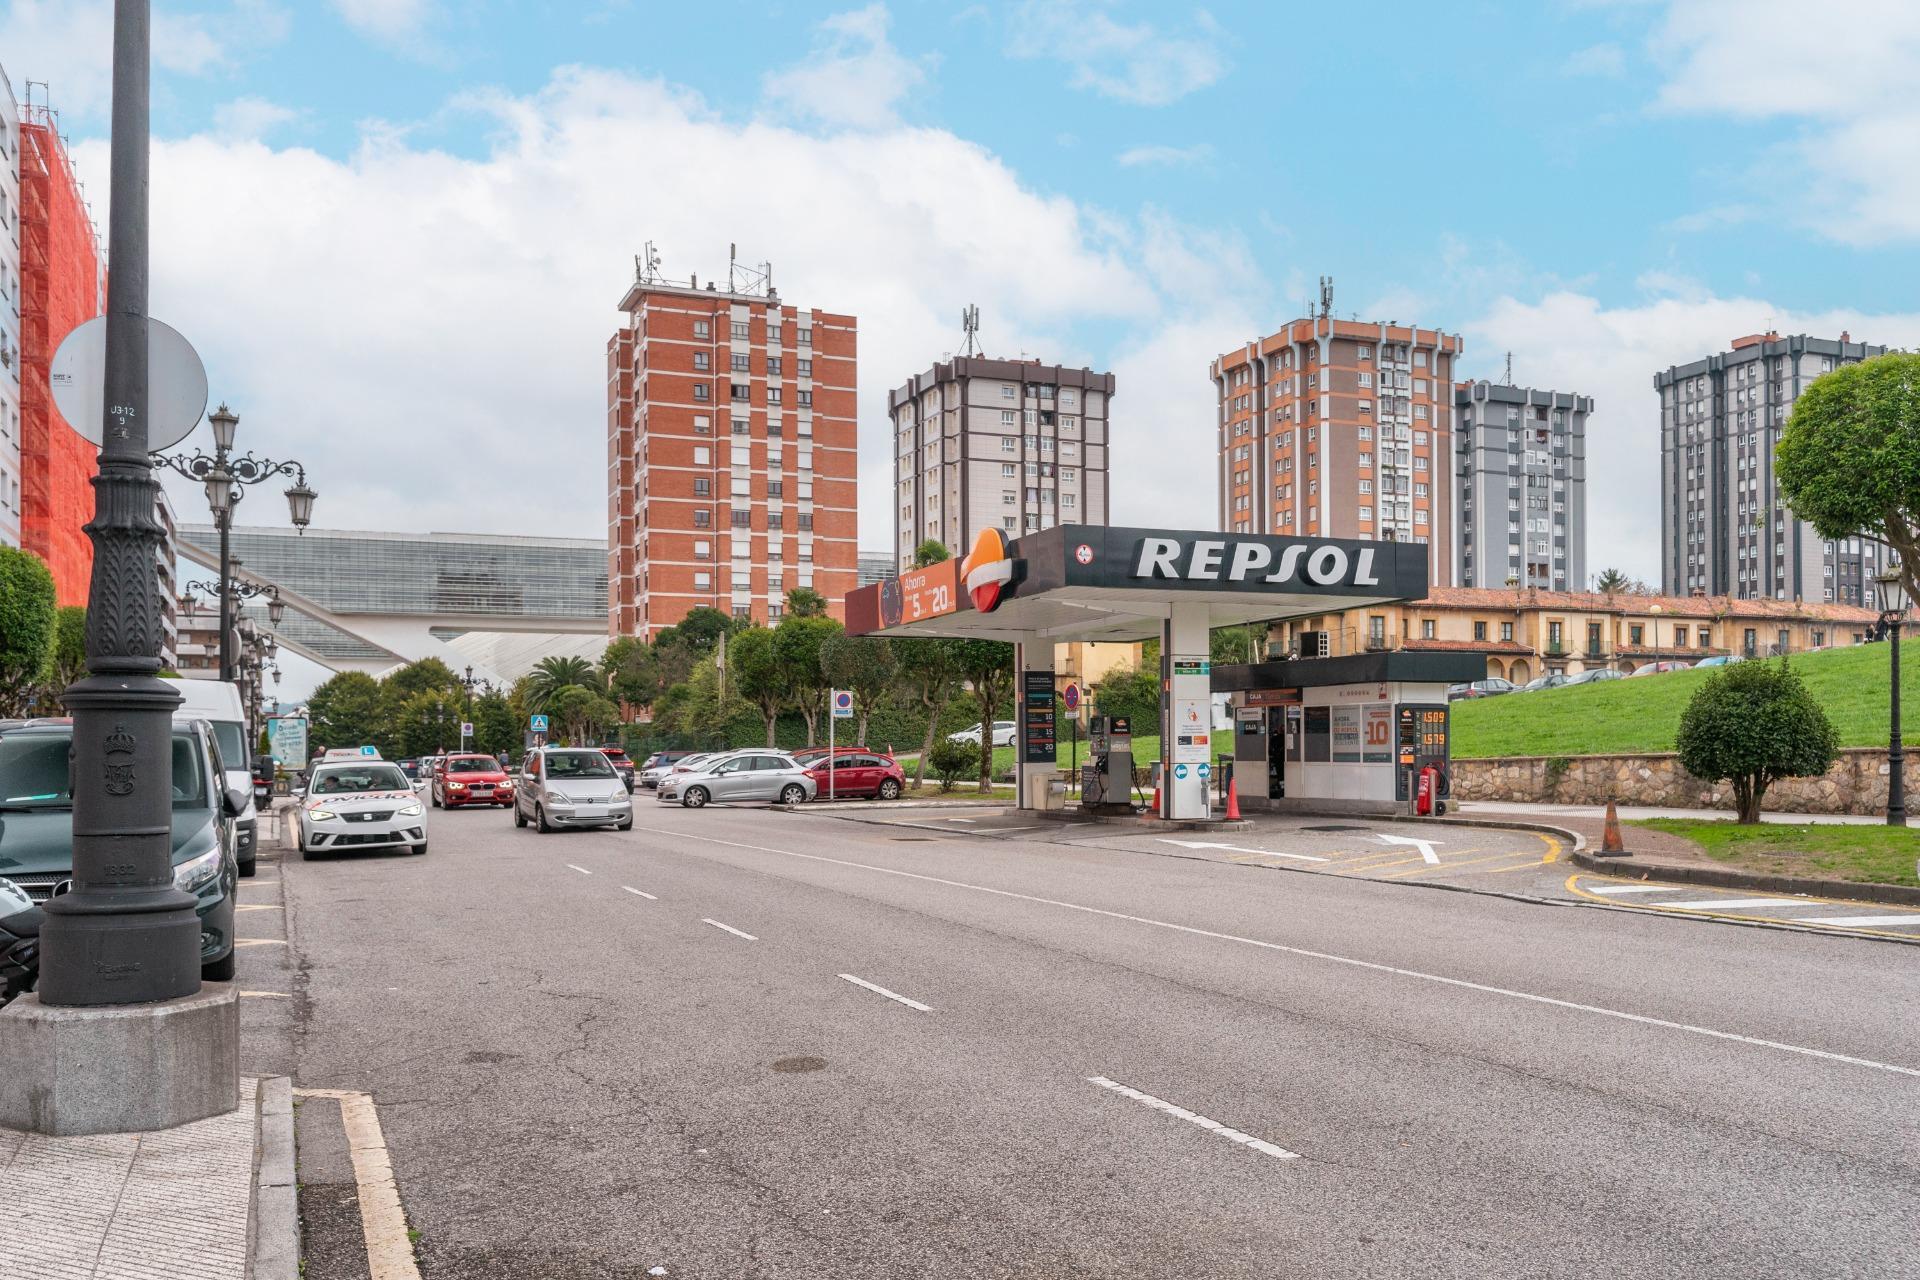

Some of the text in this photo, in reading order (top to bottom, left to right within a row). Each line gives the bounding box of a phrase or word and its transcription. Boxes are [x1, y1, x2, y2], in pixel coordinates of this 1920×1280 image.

[119, 416, 125, 425] 9
[1136, 537, 1379, 586] REPSOL
[904, 575, 926, 592] Ahorra
[912, 585, 947, 618] 5 20
